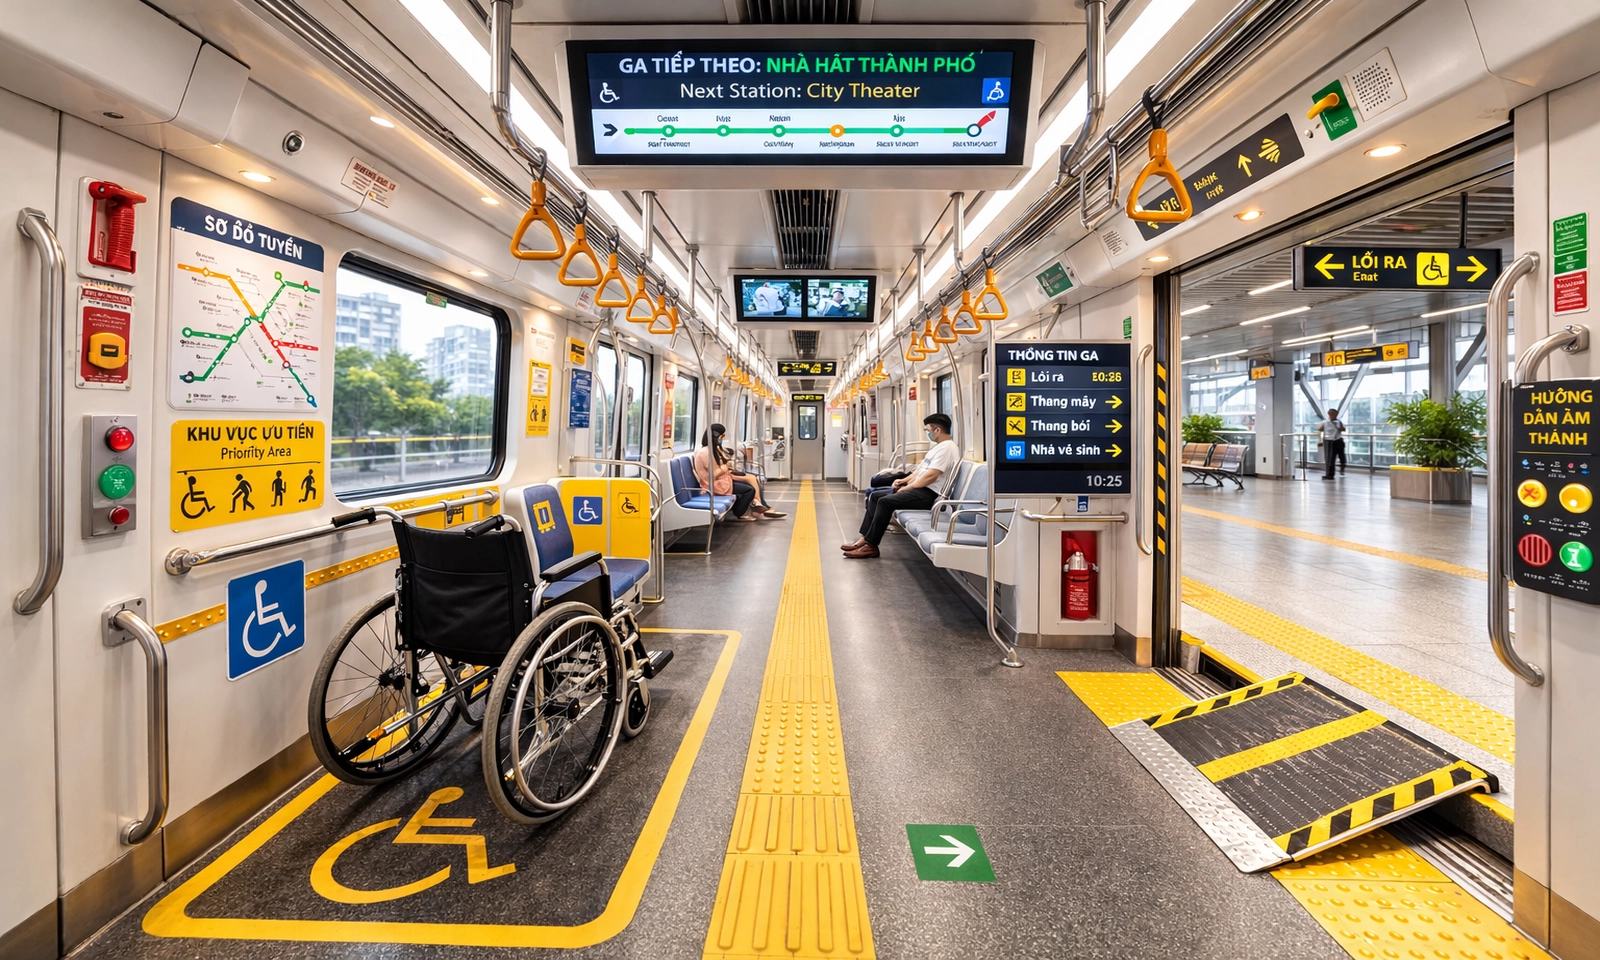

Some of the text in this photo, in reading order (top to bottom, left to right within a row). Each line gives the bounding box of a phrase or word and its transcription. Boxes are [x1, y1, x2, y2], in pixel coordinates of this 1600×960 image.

[619, 57, 648, 74] GA
[699, 57, 761, 74] THEO:
[766, 52, 810, 73] NHÀ
[858, 52, 928, 73] THÀNH
[680, 82, 921, 102] Next Station: City Theater
[1383, 255, 1408, 269] RA
[1056, 350, 1078, 361] TIN
[1080, 350, 1099, 361] GA
[1052, 373, 1065, 383] ra
[187, 426, 221, 442] KHU
[267, 446, 292, 458] Area
[1086, 474, 1123, 487] 10:25
